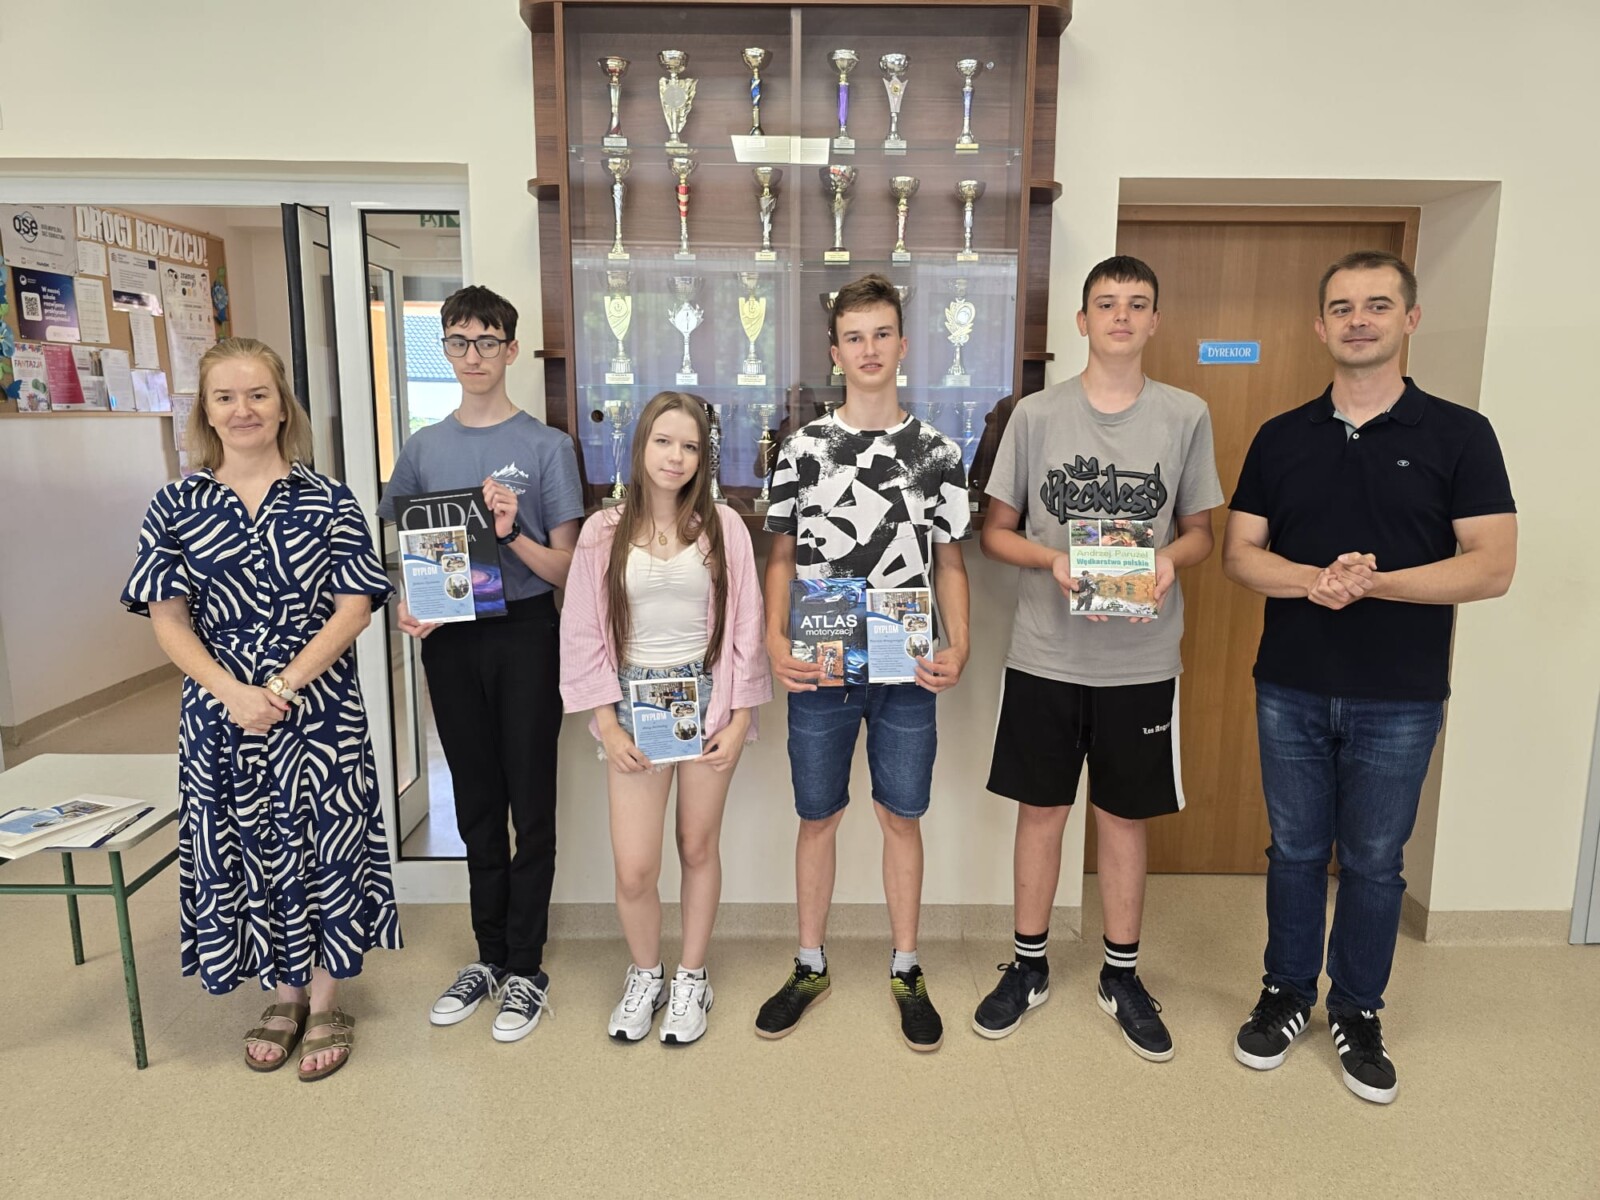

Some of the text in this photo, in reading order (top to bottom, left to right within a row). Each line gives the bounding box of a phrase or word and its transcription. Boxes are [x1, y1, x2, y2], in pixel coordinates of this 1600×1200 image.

[75, 205, 133, 250] DROGI
[136, 218, 208, 267] RODZICU!
[1207, 346, 1252, 358] DYREKTOR
[1076, 549, 1112, 558] Andrzej
[1076, 558, 1149, 567] Wędkarstwo polskie
[413, 567, 438, 576] DYPLOM
[800, 614, 858, 628] ATLAS
[805, 628, 854, 637] motoryzacji
[874, 625, 899, 633] DYPLOM
[641, 713, 667, 721] DYPLOM
